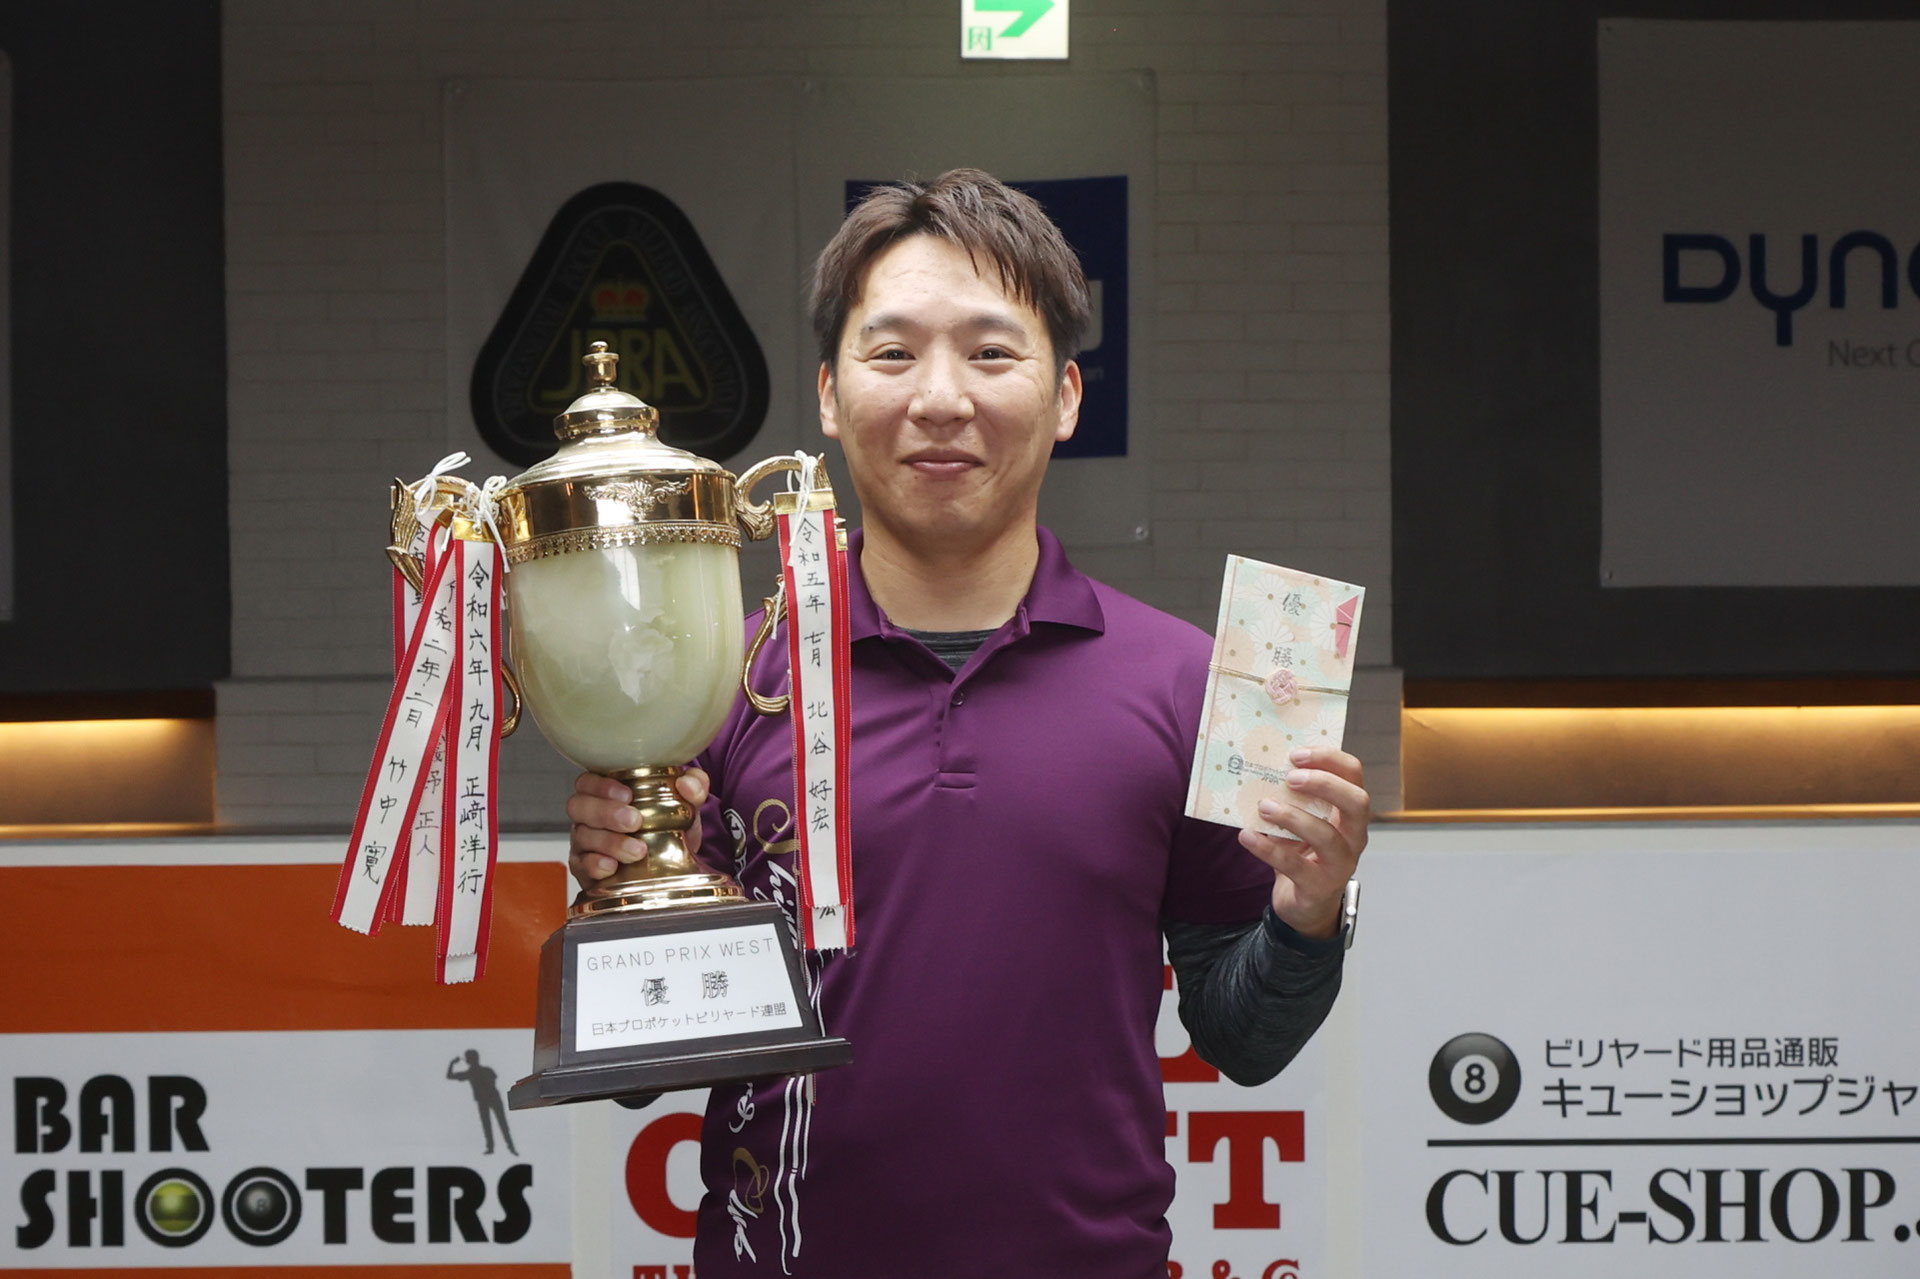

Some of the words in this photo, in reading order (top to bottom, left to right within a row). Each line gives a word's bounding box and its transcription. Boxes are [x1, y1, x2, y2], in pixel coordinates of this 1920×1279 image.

[1662, 230, 1920, 347] DYN
[1827, 339, 1897, 368] Next
[586, 951, 656, 972] GRAND
[665, 944, 717, 963] PRIX
[720, 937, 774, 957] WEST
[592, 1001, 788, 1036] 日本プロポケットビリヤード連盟
[1543, 1036, 1840, 1069] ビリヤード用品通販
[1464, 1062, 1487, 1095] 8
[1542, 1073, 1919, 1119] キューショップジャ
[14, 1073, 210, 1154] BAR
[16, 1163, 534, 1249] SHOOTERS
[1425, 1167, 1920, 1246] CUE-SHOP.
